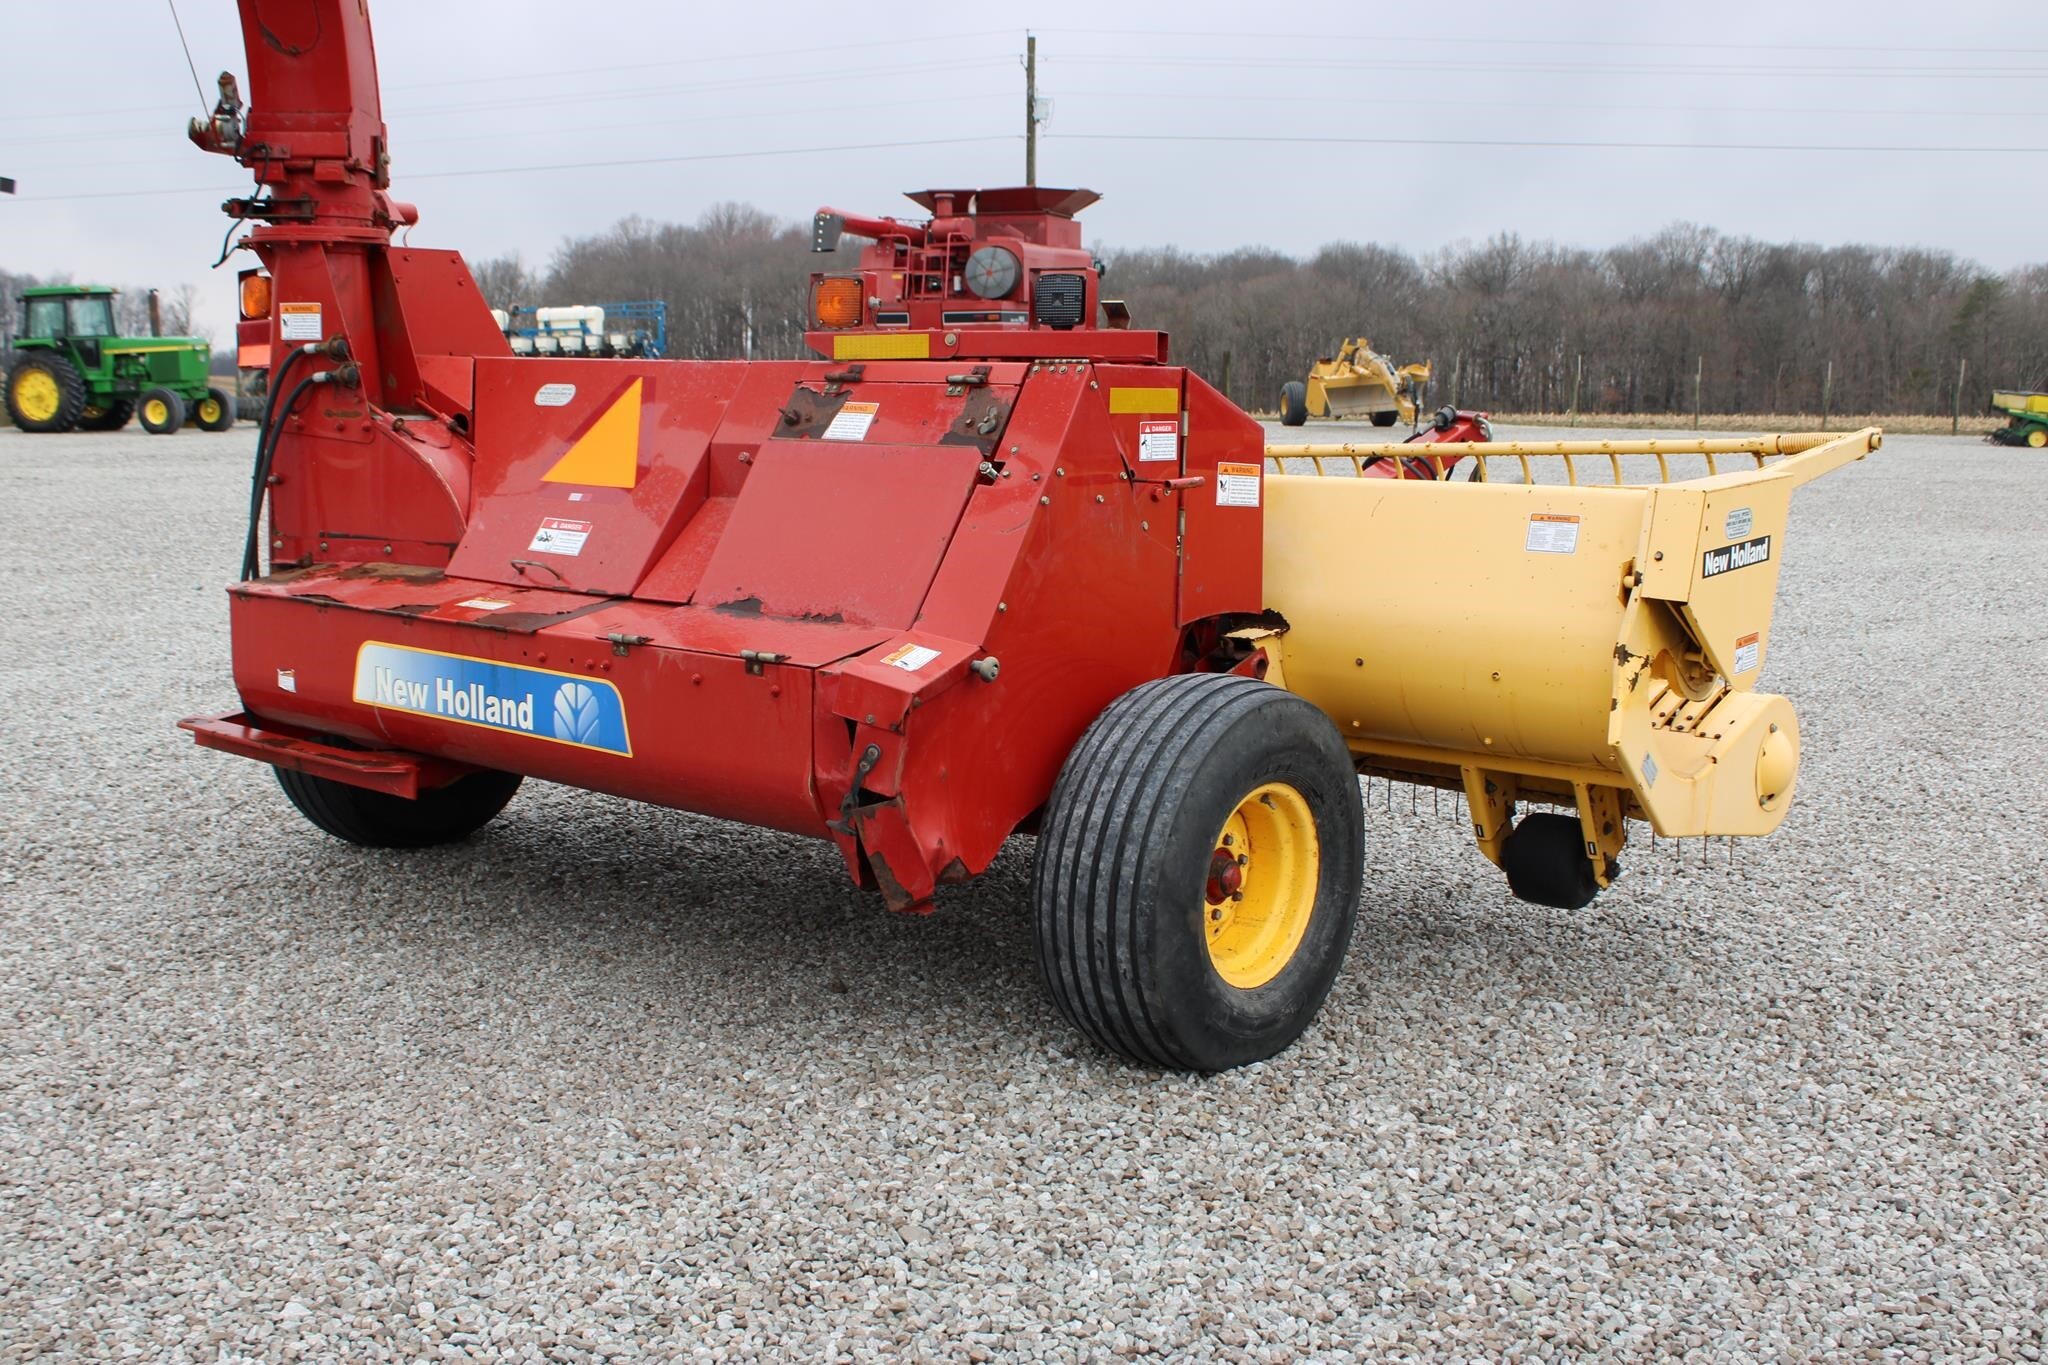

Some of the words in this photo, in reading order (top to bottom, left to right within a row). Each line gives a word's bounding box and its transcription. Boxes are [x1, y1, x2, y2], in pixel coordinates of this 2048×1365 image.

[1231, 466, 1254, 474] WARNING
[1547, 514, 1571, 522] WARNING
[1704, 551, 1729, 577] New
[1730, 537, 1769, 569] Holland
[375, 665, 428, 709] New
[436, 677, 534, 730] Holland
